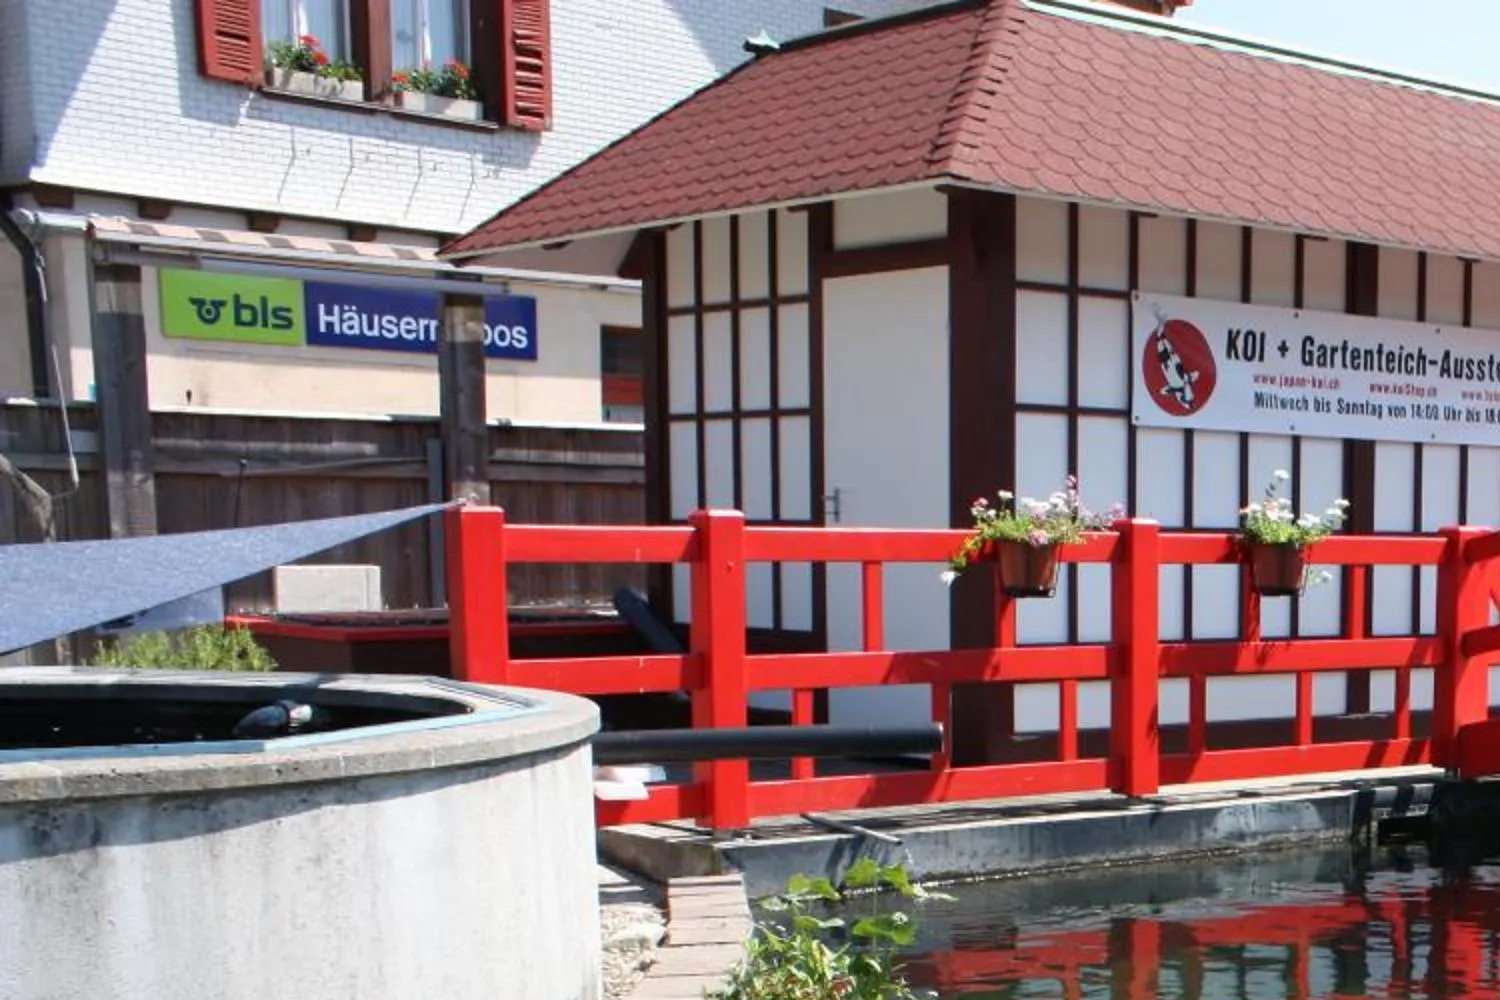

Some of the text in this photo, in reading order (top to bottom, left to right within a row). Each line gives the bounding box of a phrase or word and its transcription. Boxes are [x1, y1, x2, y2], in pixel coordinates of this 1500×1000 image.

[233, 293, 293, 330] bls
[1226, 328, 1266, 363] KOI
[1254, 391, 1309, 411] Mittwoch
[1314, 396, 1331, 414] bis
[1337, 398, 1383, 419] Sonntag
[1388, 404, 1407, 418] von
[1443, 406, 1461, 422] Uhr
[1465, 408, 1481, 423] bis
